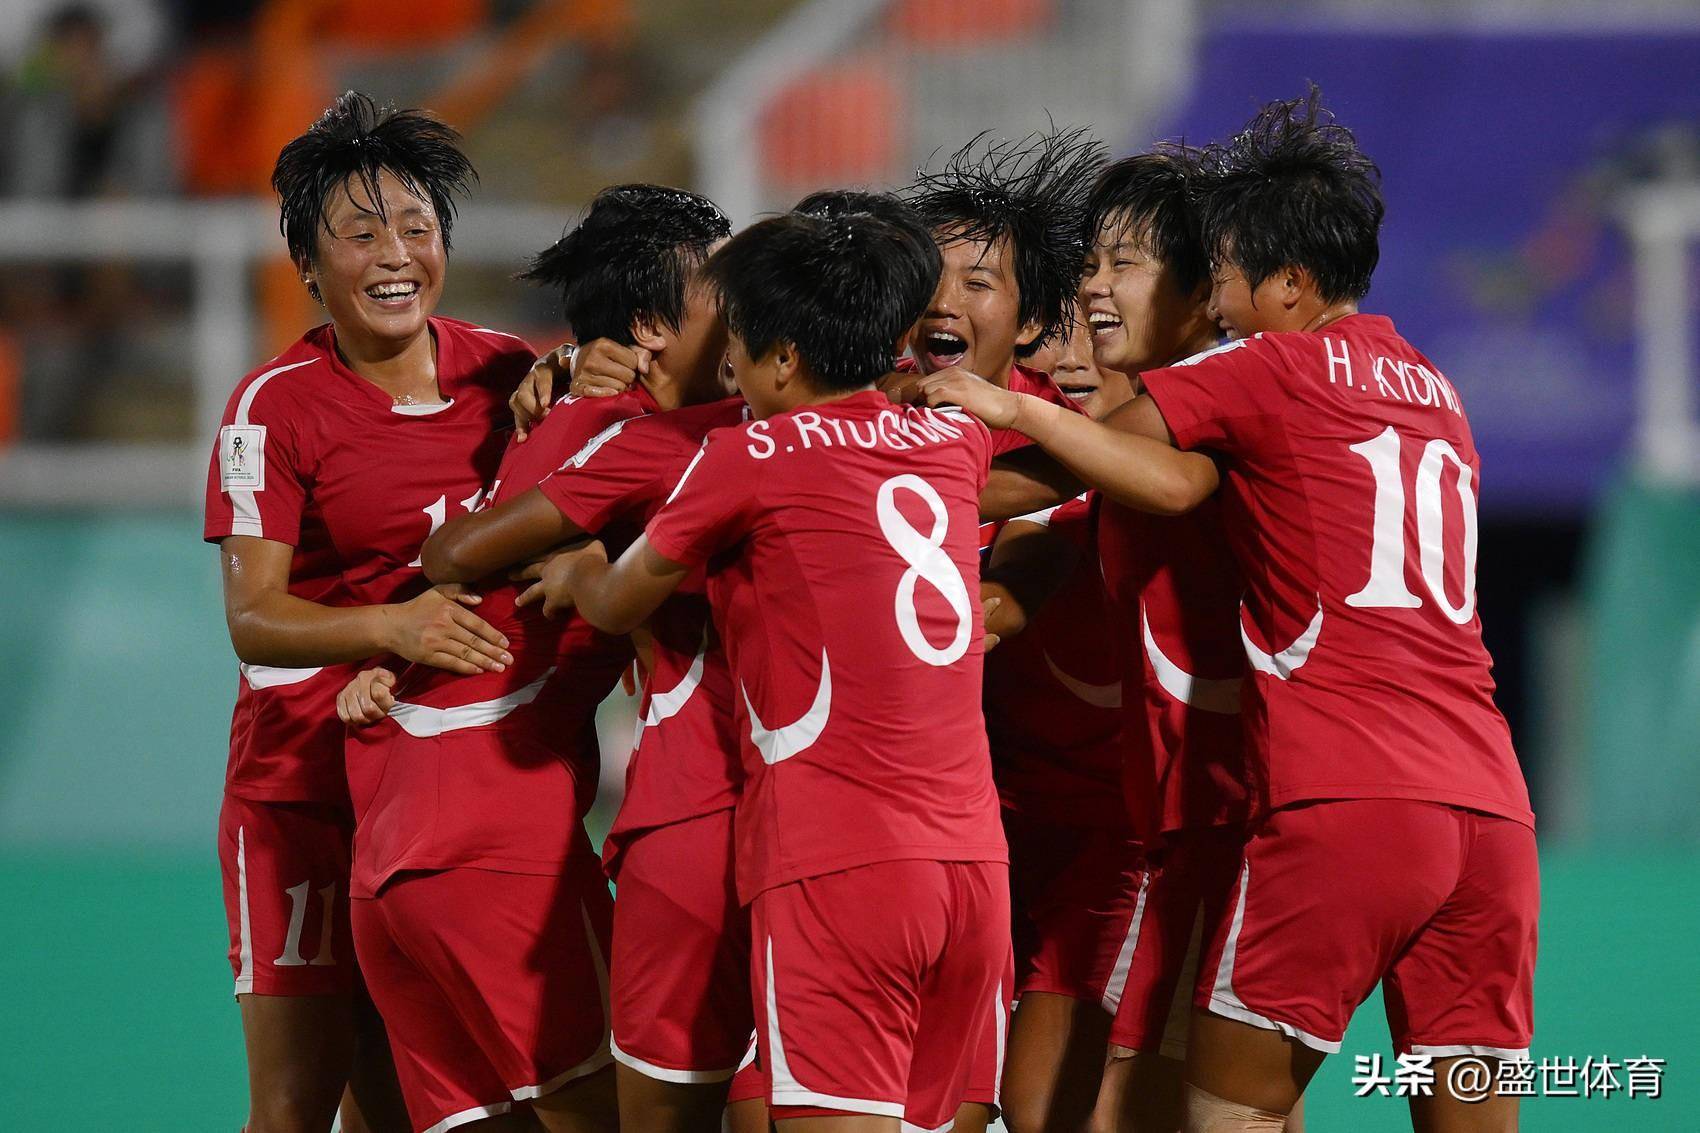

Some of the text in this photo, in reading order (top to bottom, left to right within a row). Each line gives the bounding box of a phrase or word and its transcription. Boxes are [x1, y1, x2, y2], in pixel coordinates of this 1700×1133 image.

[876, 473, 973, 666] 8
[1345, 425, 1478, 625] 10
[273, 879, 337, 965] 11
